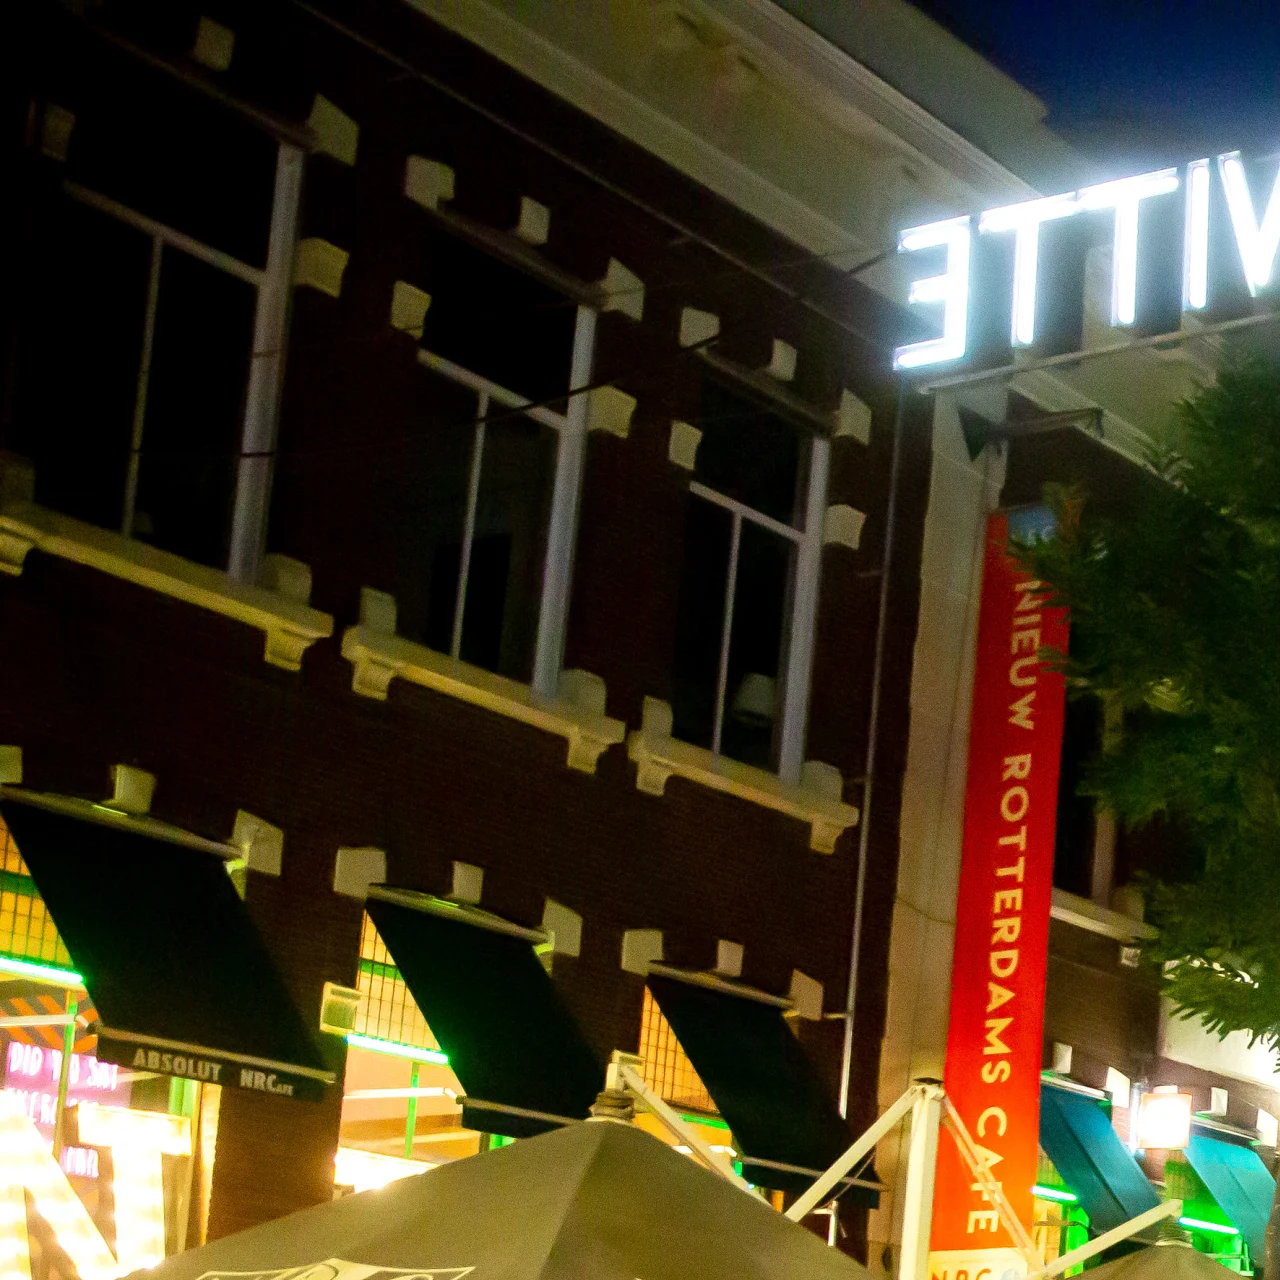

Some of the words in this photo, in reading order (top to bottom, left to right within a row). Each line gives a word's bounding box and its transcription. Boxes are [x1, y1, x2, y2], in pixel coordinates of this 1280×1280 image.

[1008, 579, 1042, 730] NIEUW
[980, 753, 1032, 1084] ROTTERDAMS
[132, 1048, 222, 1082] ABSOLUT
